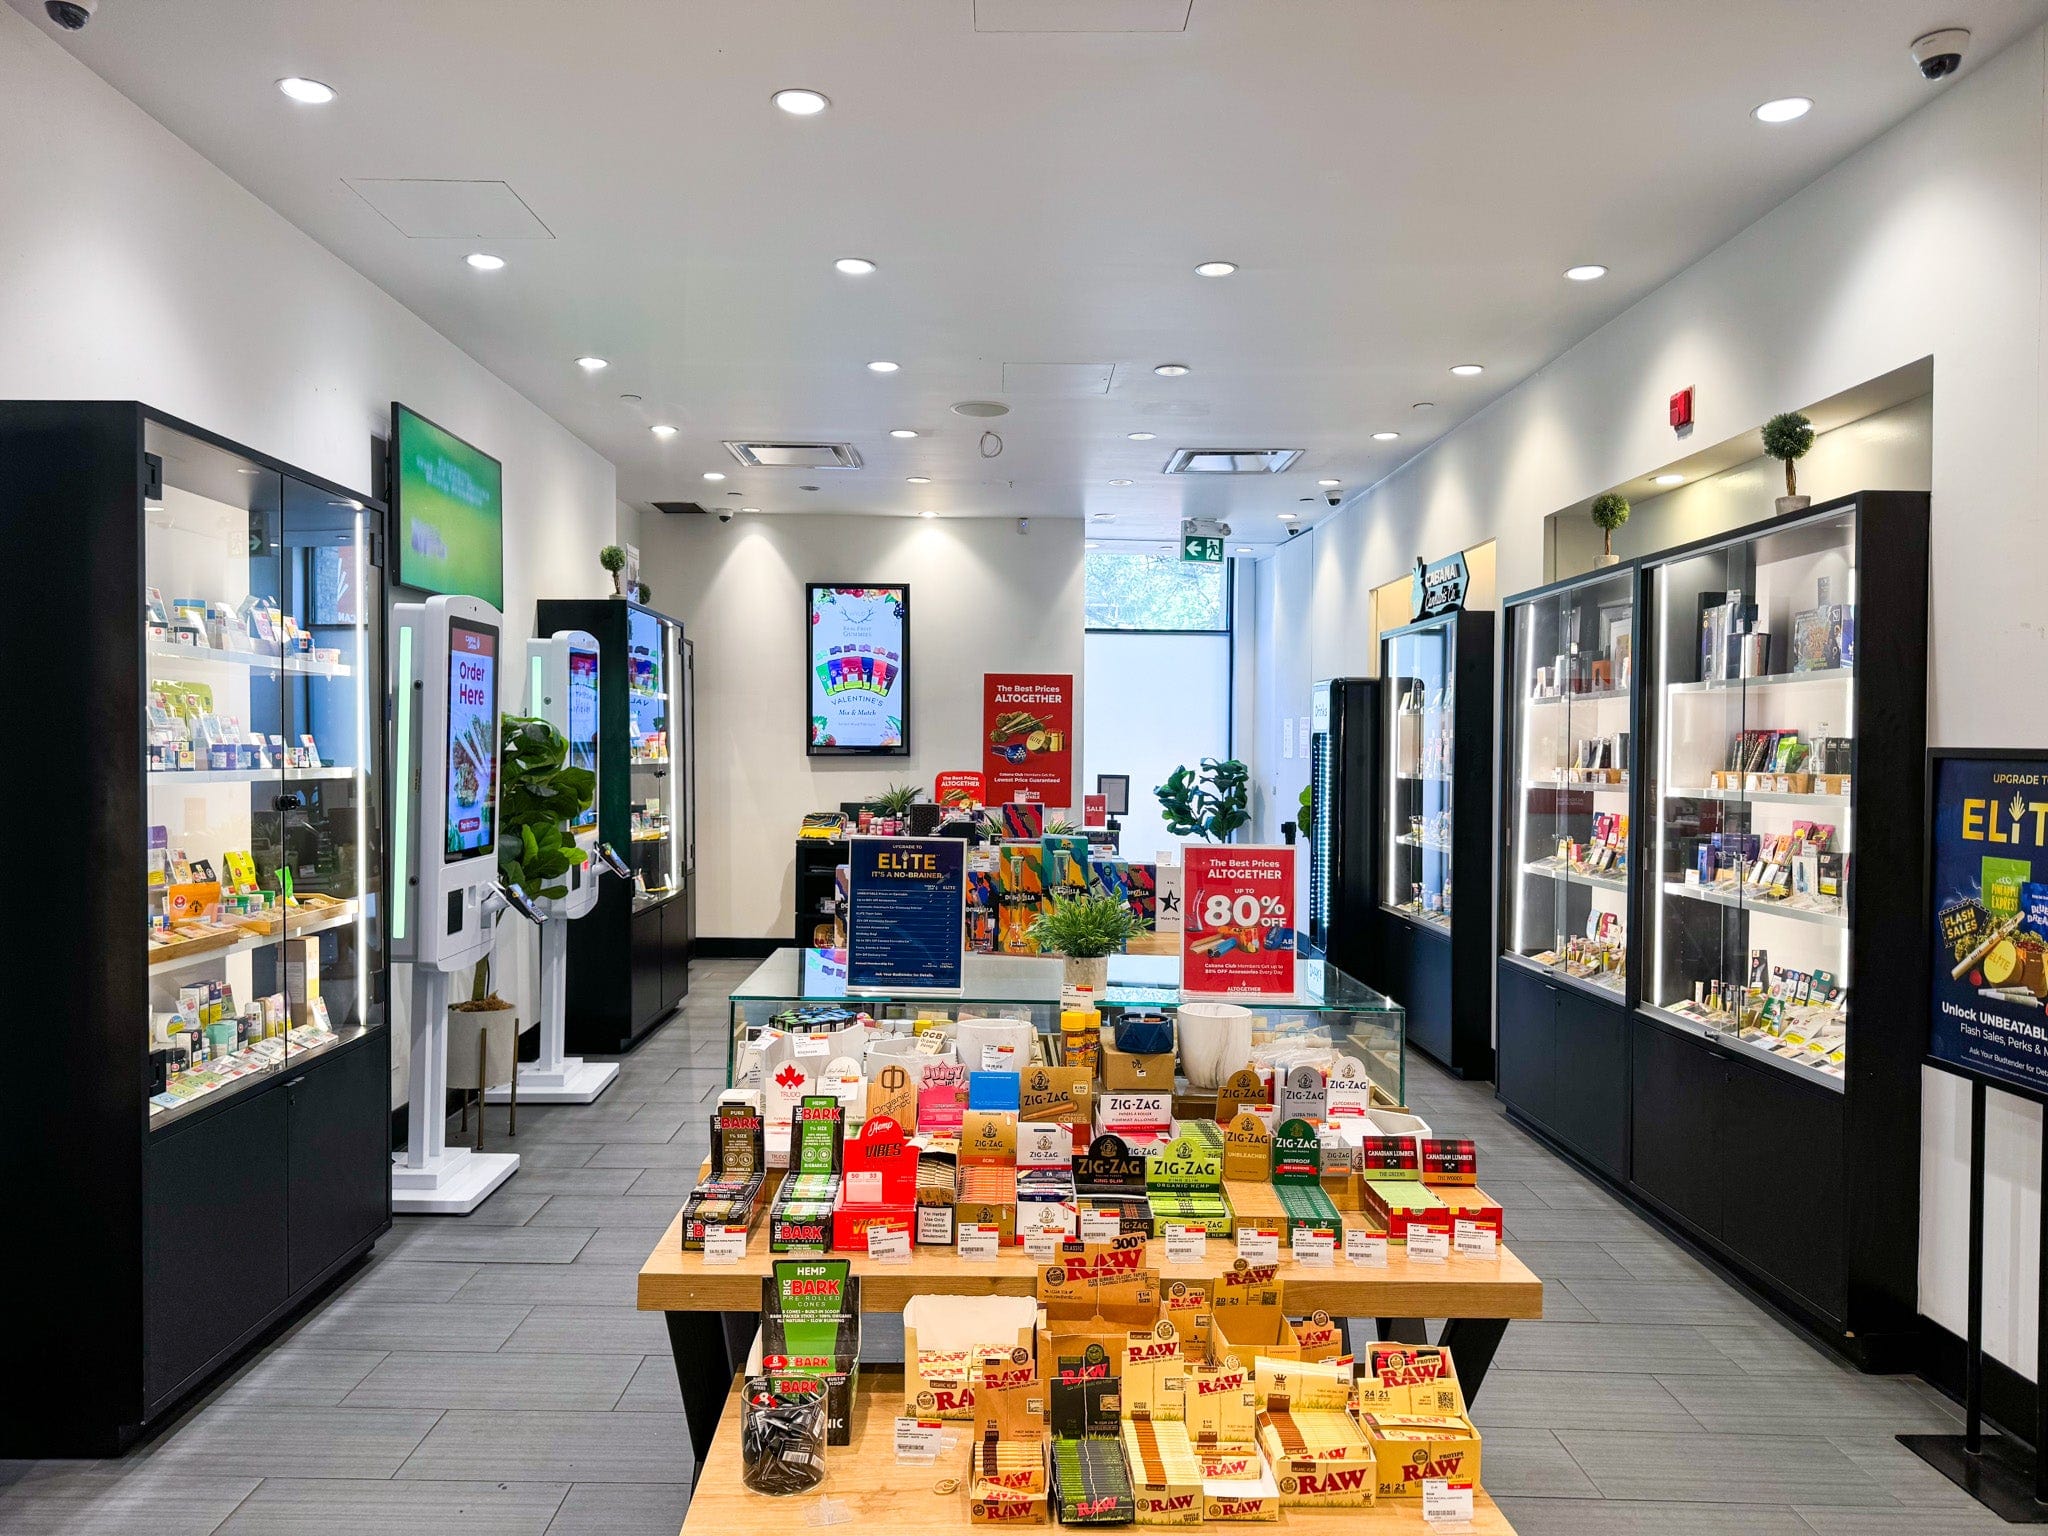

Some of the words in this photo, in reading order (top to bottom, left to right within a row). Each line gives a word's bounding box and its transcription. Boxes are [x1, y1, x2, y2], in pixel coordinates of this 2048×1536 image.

[1425, 564, 1456, 587] CABANA
[459, 661, 485, 682] Order
[459, 684, 485, 706] Here
[1014, 685, 1033, 693] Best
[1035, 685, 1060, 693] Prices
[831, 695, 884, 707] VALENTINE'S
[994, 694, 1062, 704] ALTOGETHER
[1993, 774, 2039, 785] UPGRADE
[1210, 859, 1227, 867] The
[1229, 859, 1249, 867] Best
[1252, 860, 1280, 868] Prices
[894, 871, 944, 879] NO-BRAINER.
[1208, 869, 1282, 880] ALTOGETHER
[1204, 895, 1285, 927] 80%
[1991, 895, 2018, 912] EXPRESS
[1260, 918, 1287, 927] OFF
[1944, 908, 1975, 929] FLASH
[1947, 920, 1978, 939] SALES
[1942, 1001, 1977, 1021] Unlock
[922, 1031, 943, 1040] OCB
[1960, 1023, 1981, 1038] Flash
[1983, 1029, 2006, 1047] Sales,
[2008, 1036, 2033, 1053] Perks
[2034, 1044, 2041, 1056] &
[1969, 1046, 1980, 1056] Ask
[1981, 1049, 1993, 1059] Your
[1995, 1055, 2025, 1070] Budtender
[2026, 1063, 2035, 1073] for
[923, 1065, 965, 1081] JUICY
[1330, 1080, 1367, 1090] ZIG-ZAG
[1024, 1092, 1069, 1106] ZIG-ZAG
[1222, 1089, 1265, 1099] ZIG-ZAG
[1286, 1090, 1324, 1100] ZIG-ZAG
[873, 1091, 910, 1115] Organic
[1111, 1098, 1162, 1110] ZIG-ZAG
[802, 1107, 841, 1120] BARK
[721, 1116, 761, 1129] BARK
[868, 1120, 893, 1137] Hemp
[975, 1140, 1003, 1148] ZIG-ZAG
[1227, 1132, 1268, 1144] ZIG-ZAG
[1276, 1137, 1318, 1149] ZIG-ZAG
[866, 1143, 902, 1158] VIBES
[1127, 1148, 1158, 1156] ZIG-ZAG
[1078, 1158, 1141, 1175] ZIG-ZAG
[1154, 1161, 1216, 1175] ZIG-ZAG
[782, 1226, 823, 1240] BARK
[1121, 1222, 1149, 1230] IG-ZAG
[1112, 1235, 1147, 1250] 300's
[797, 1267, 827, 1276] HEMP
[1064, 1249, 1143, 1282] RAW
[1226, 1268, 1276, 1287] RAW
[783, 1280, 792, 1296] BIG
[791, 1279, 840, 1296] BARK
[1171, 1297, 1203, 1309] RAW
[773, 1356, 779, 1364] 8
[1128, 1342, 1178, 1363] RAW
[795, 1357, 829, 1367] BARK
[1416, 1356, 1440, 1365] PROTIPS
[984, 1368, 1033, 1390] RAW
[1061, 1363, 1108, 1386] RAW
[1380, 1364, 1439, 1388] RAW
[781, 1381, 818, 1394] BARK
[1198, 1373, 1244, 1397] RAW
[934, 1388, 975, 1412] RA
[1364, 1390, 1375, 1398] 24
[1378, 1390, 1389, 1398] 21
[1439, 1450, 1464, 1460] PROTIPS
[1206, 1460, 1249, 1478] RAW
[1402, 1457, 1463, 1483] RAW
[1298, 1468, 1368, 1496] RAW
[987, 1500, 1033, 1520] RAW
[1077, 1496, 1118, 1517] RAW
[1150, 1494, 1195, 1512] RAW
[1221, 1499, 1263, 1516] RAW
